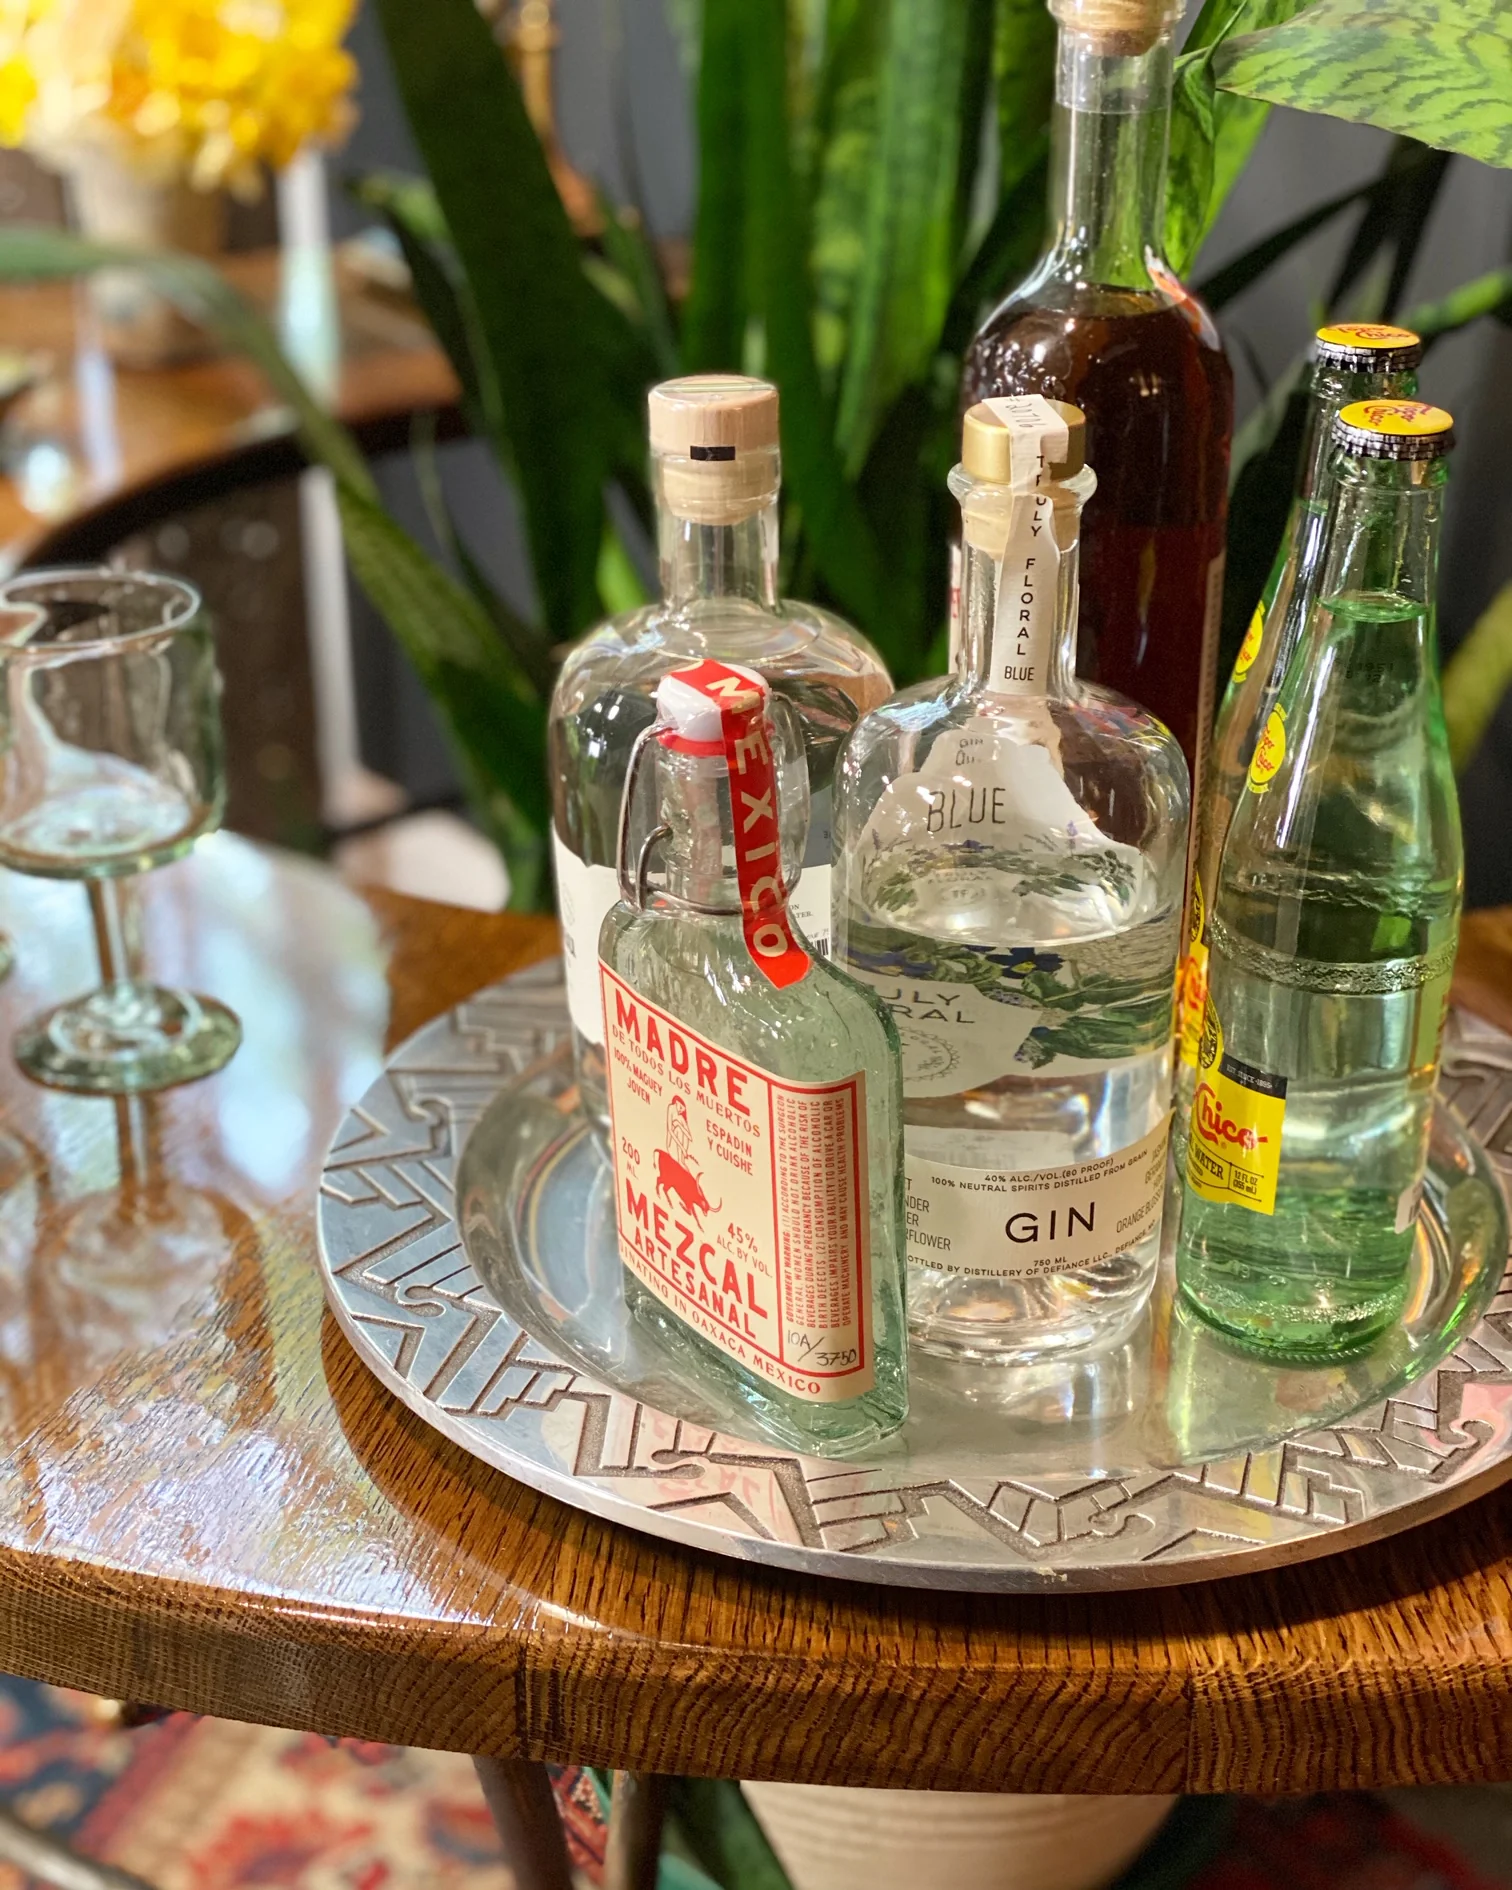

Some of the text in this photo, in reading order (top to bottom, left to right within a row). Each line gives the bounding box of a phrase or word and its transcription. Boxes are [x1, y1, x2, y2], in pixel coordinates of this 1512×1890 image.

[1017, 558, 1036, 656] FLORAL
[1004, 665, 1035, 681] BLUE
[706, 675, 789, 958] MEXICO
[926, 787, 1006, 834] BLUE
[616, 988, 750, 1116] MADRE
[612, 1024, 760, 1138] DE TODOS LOS MUERTOS
[614, 1047, 663, 1096] 100% MAGUEY
[627, 1078, 651, 1105] JOVEN
[823, 1100, 832, 1111] OR
[777, 1095, 785, 1133] SURGEON
[787, 1098, 797, 1152] ALCOHOLIC
[811, 1101, 822, 1153] ALCOHOLIC
[824, 1114, 833, 1131] CAR
[835, 1098, 845, 1141] PROBLEMS
[1193, 1082, 1269, 1150] Chico
[622, 1136, 640, 1165] 200
[706, 1119, 752, 1158] ESPADIN
[778, 1137, 786, 1150] THE
[825, 1140, 834, 1167] DRIVE
[707, 1136, 753, 1176] Y CUISHE
[779, 1153, 786, 1163] TO
[789, 1156, 798, 1184] DRINK
[813, 1157, 822, 1168] OF
[837, 1145, 846, 1174] HEALTH
[931, 1176, 955, 1187] 100%
[959, 1182, 1007, 1192] NEUTRAL
[1011, 1183, 1050, 1192] SPIRITS
[1054, 1173, 1101, 1189] DISTILLED
[1103, 1162, 1125, 1177] FROM
[1127, 1148, 1147, 1166] GRAIN
[985, 1174, 1006, 1183] 40%
[1080, 1158, 1114, 1174] PROOF)
[779, 1167, 789, 1213] ACCORDING
[825, 1171, 835, 1180] TO
[838, 1177, 847, 1202] CAUSE
[1234, 1169, 1258, 1185] 12 FL OZ
[791, 1188, 799, 1205] NOT
[815, 1172, 825, 1237] CONSUMPTION
[826, 1184, 836, 1216] ABILITY
[791, 1209, 801, 1244] SHOULD
[798, 1101, 815, 1328] BEVERAGES DURING PREGNANCY BECAUSE OF THE RISK OF
[827, 1219, 837, 1240] YOUR
[838, 1206, 848, 1221] MAY
[1005, 1201, 1095, 1243] GIN
[727, 1222, 758, 1253] 45%
[839, 1224, 848, 1239] AND
[626, 1178, 767, 1319] MEZCAL
[737, 1247, 748, 1262] BY
[752, 1256, 773, 1278] VOL.
[793, 1248, 802, 1280] WOMEN
[816, 1242, 825, 1254] (2)
[828, 1244, 838, 1278] IMPAIRS
[1033, 1256, 1067, 1267] 750 ML
[635, 1226, 756, 1339] ARTESANAL
[947, 1265, 960, 1273] BY
[964, 1267, 1022, 1276] DISTILLERY
[1026, 1267, 1040, 1276] OF
[1043, 1258, 1090, 1274] DEFIANCE
[784, 1271, 794, 1322] GOVERNMENT
[829, 1282, 840, 1328] BEVERAGES
[841, 1292, 851, 1326] OPERATE
[818, 1303, 828, 1328] BIRTH
[674, 1295, 687, 1313] IN
[692, 1310, 745, 1358] OAXACA
[753, 1354, 821, 1394] MEXICO
